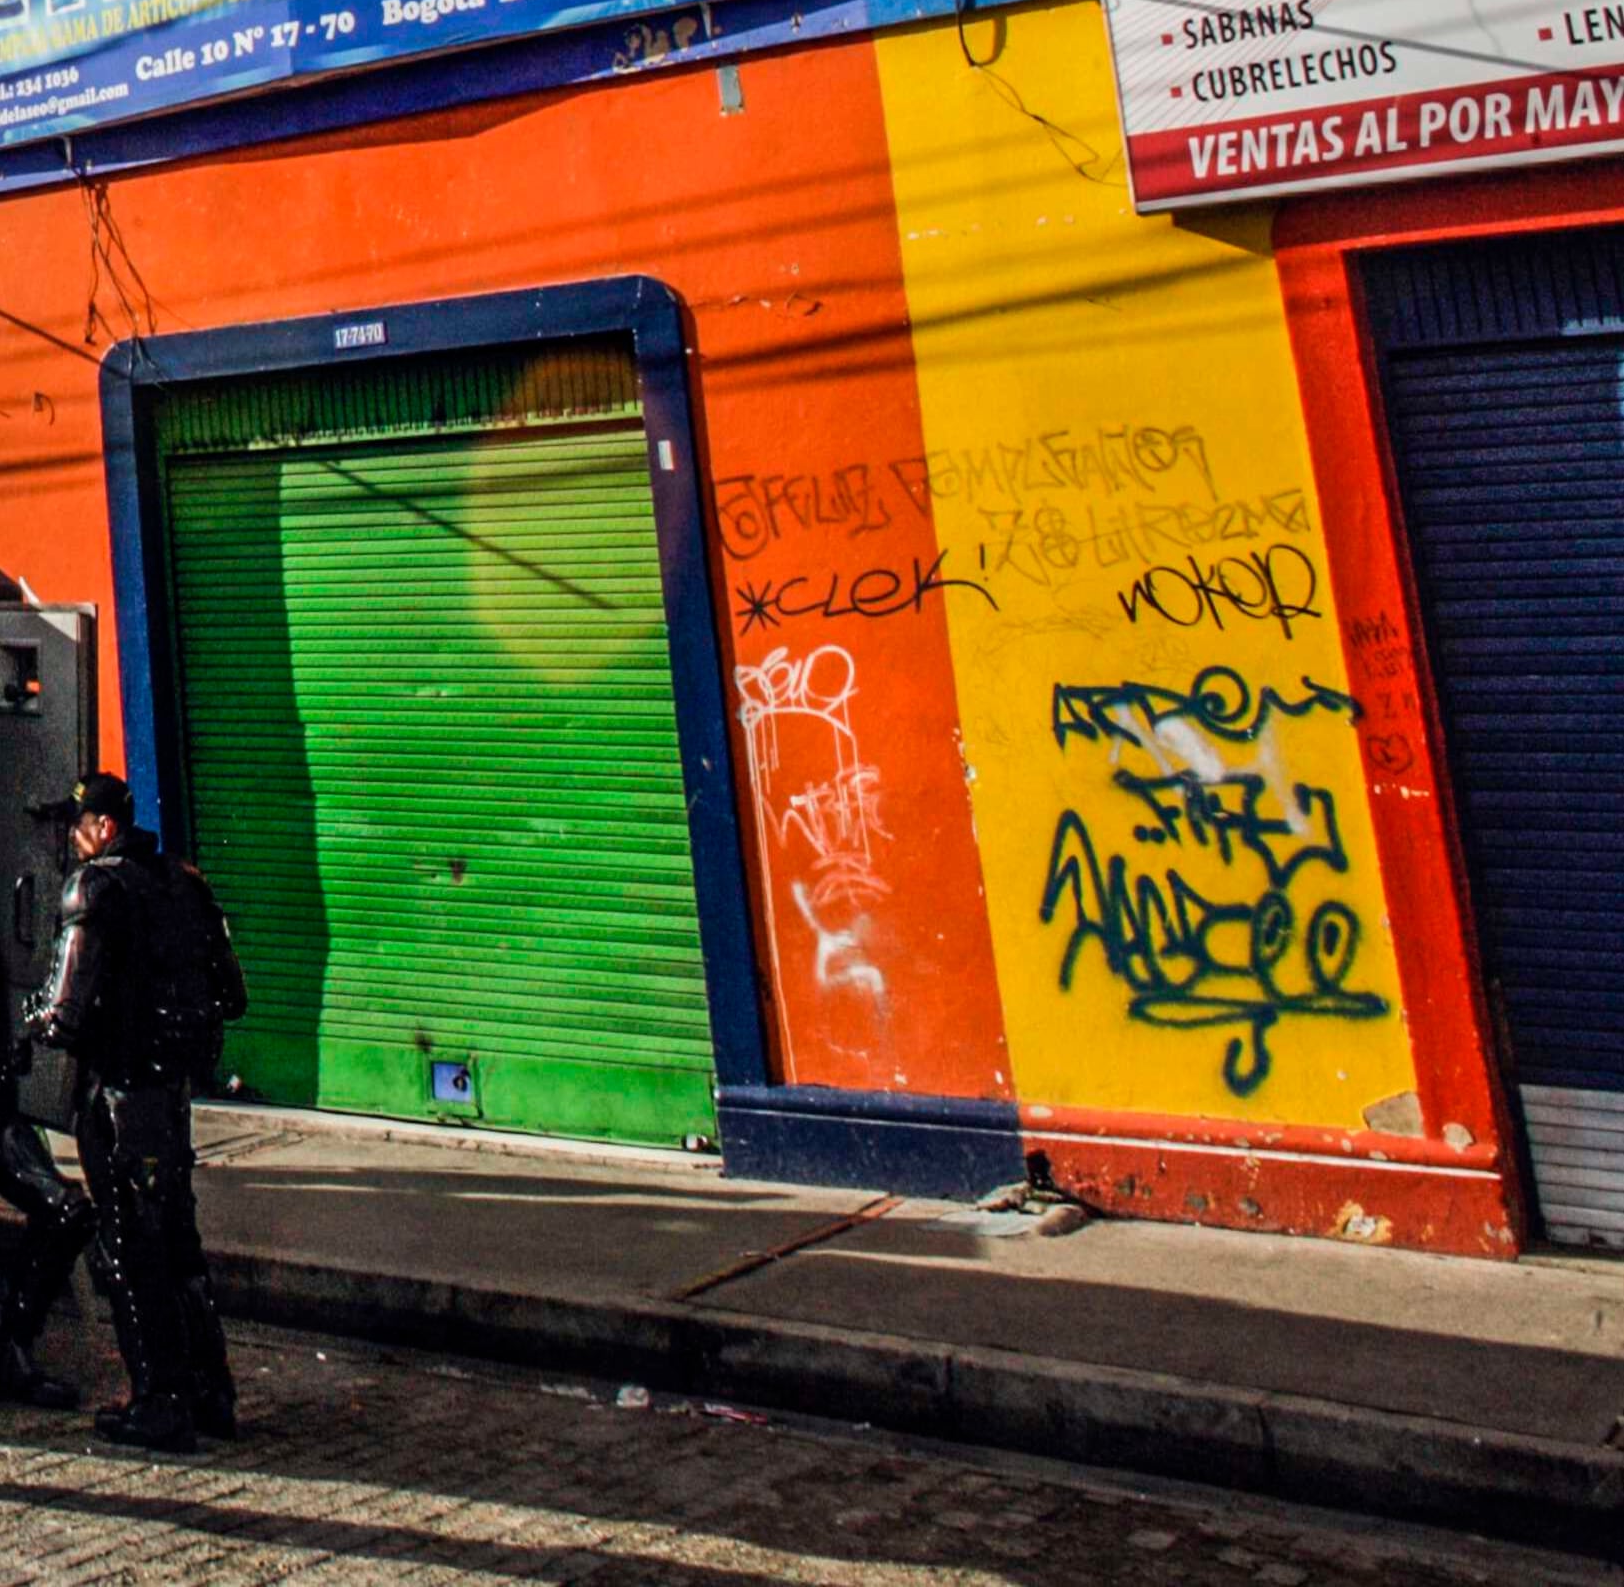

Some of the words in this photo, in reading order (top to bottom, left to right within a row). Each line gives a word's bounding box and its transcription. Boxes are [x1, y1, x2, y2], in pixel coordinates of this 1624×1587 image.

[103, 7, 123, 35] DE
[134, 45, 195, 81] Calle
[200, 39, 229, 66] 10
[270, 21, 299, 48] 17
[319, 11, 356, 41] 70
[16, 74, 43, 98] 234
[45, 66, 80, 90] 1036
[1192, 40, 1398, 103] CUBRELECHOS
[1189, 114, 1342, 179] VENTAS
[1354, 106, 1408, 156] AL
[1419, 91, 1512, 149] POR
